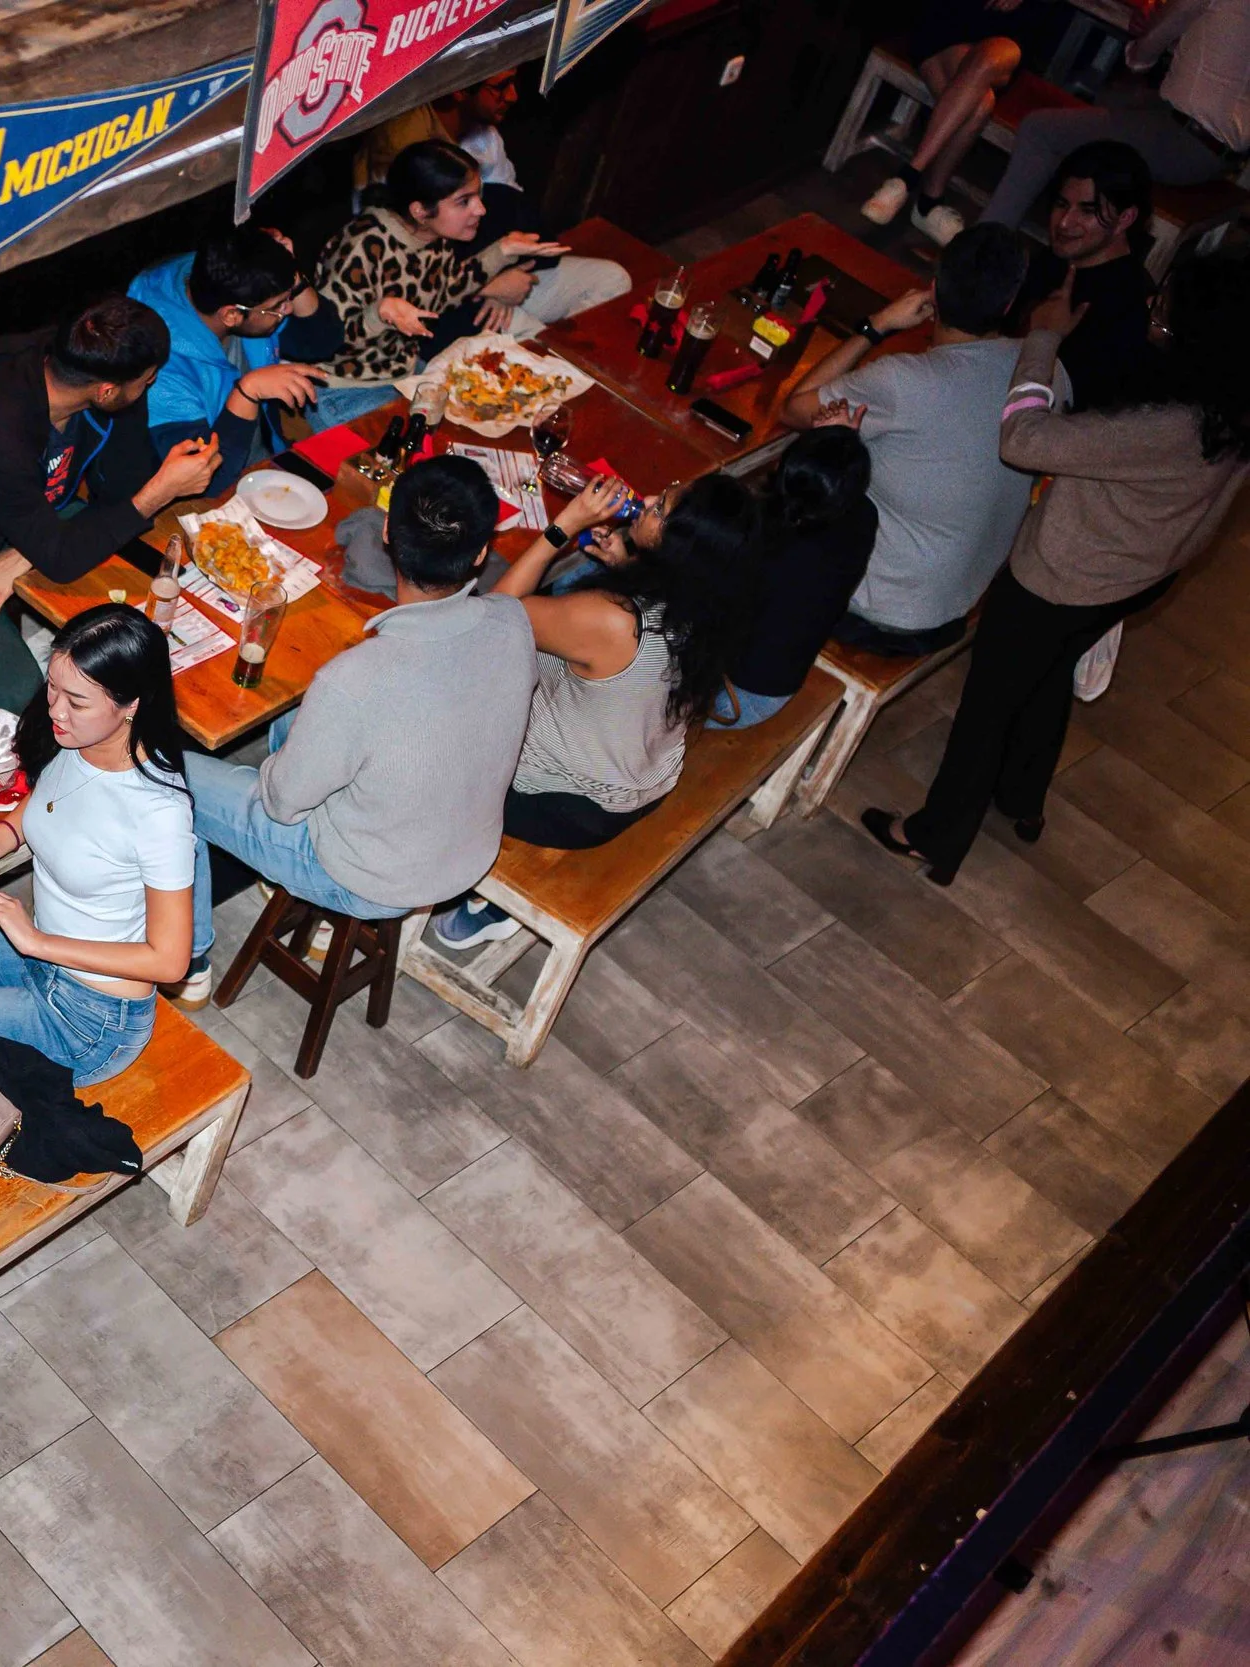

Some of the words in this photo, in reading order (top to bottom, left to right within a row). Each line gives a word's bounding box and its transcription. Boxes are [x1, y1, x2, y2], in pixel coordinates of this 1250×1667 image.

[383, 0, 497, 56] BUCKEY
[255, 46, 316, 154] OHIO
[306, 29, 377, 104] STATE
